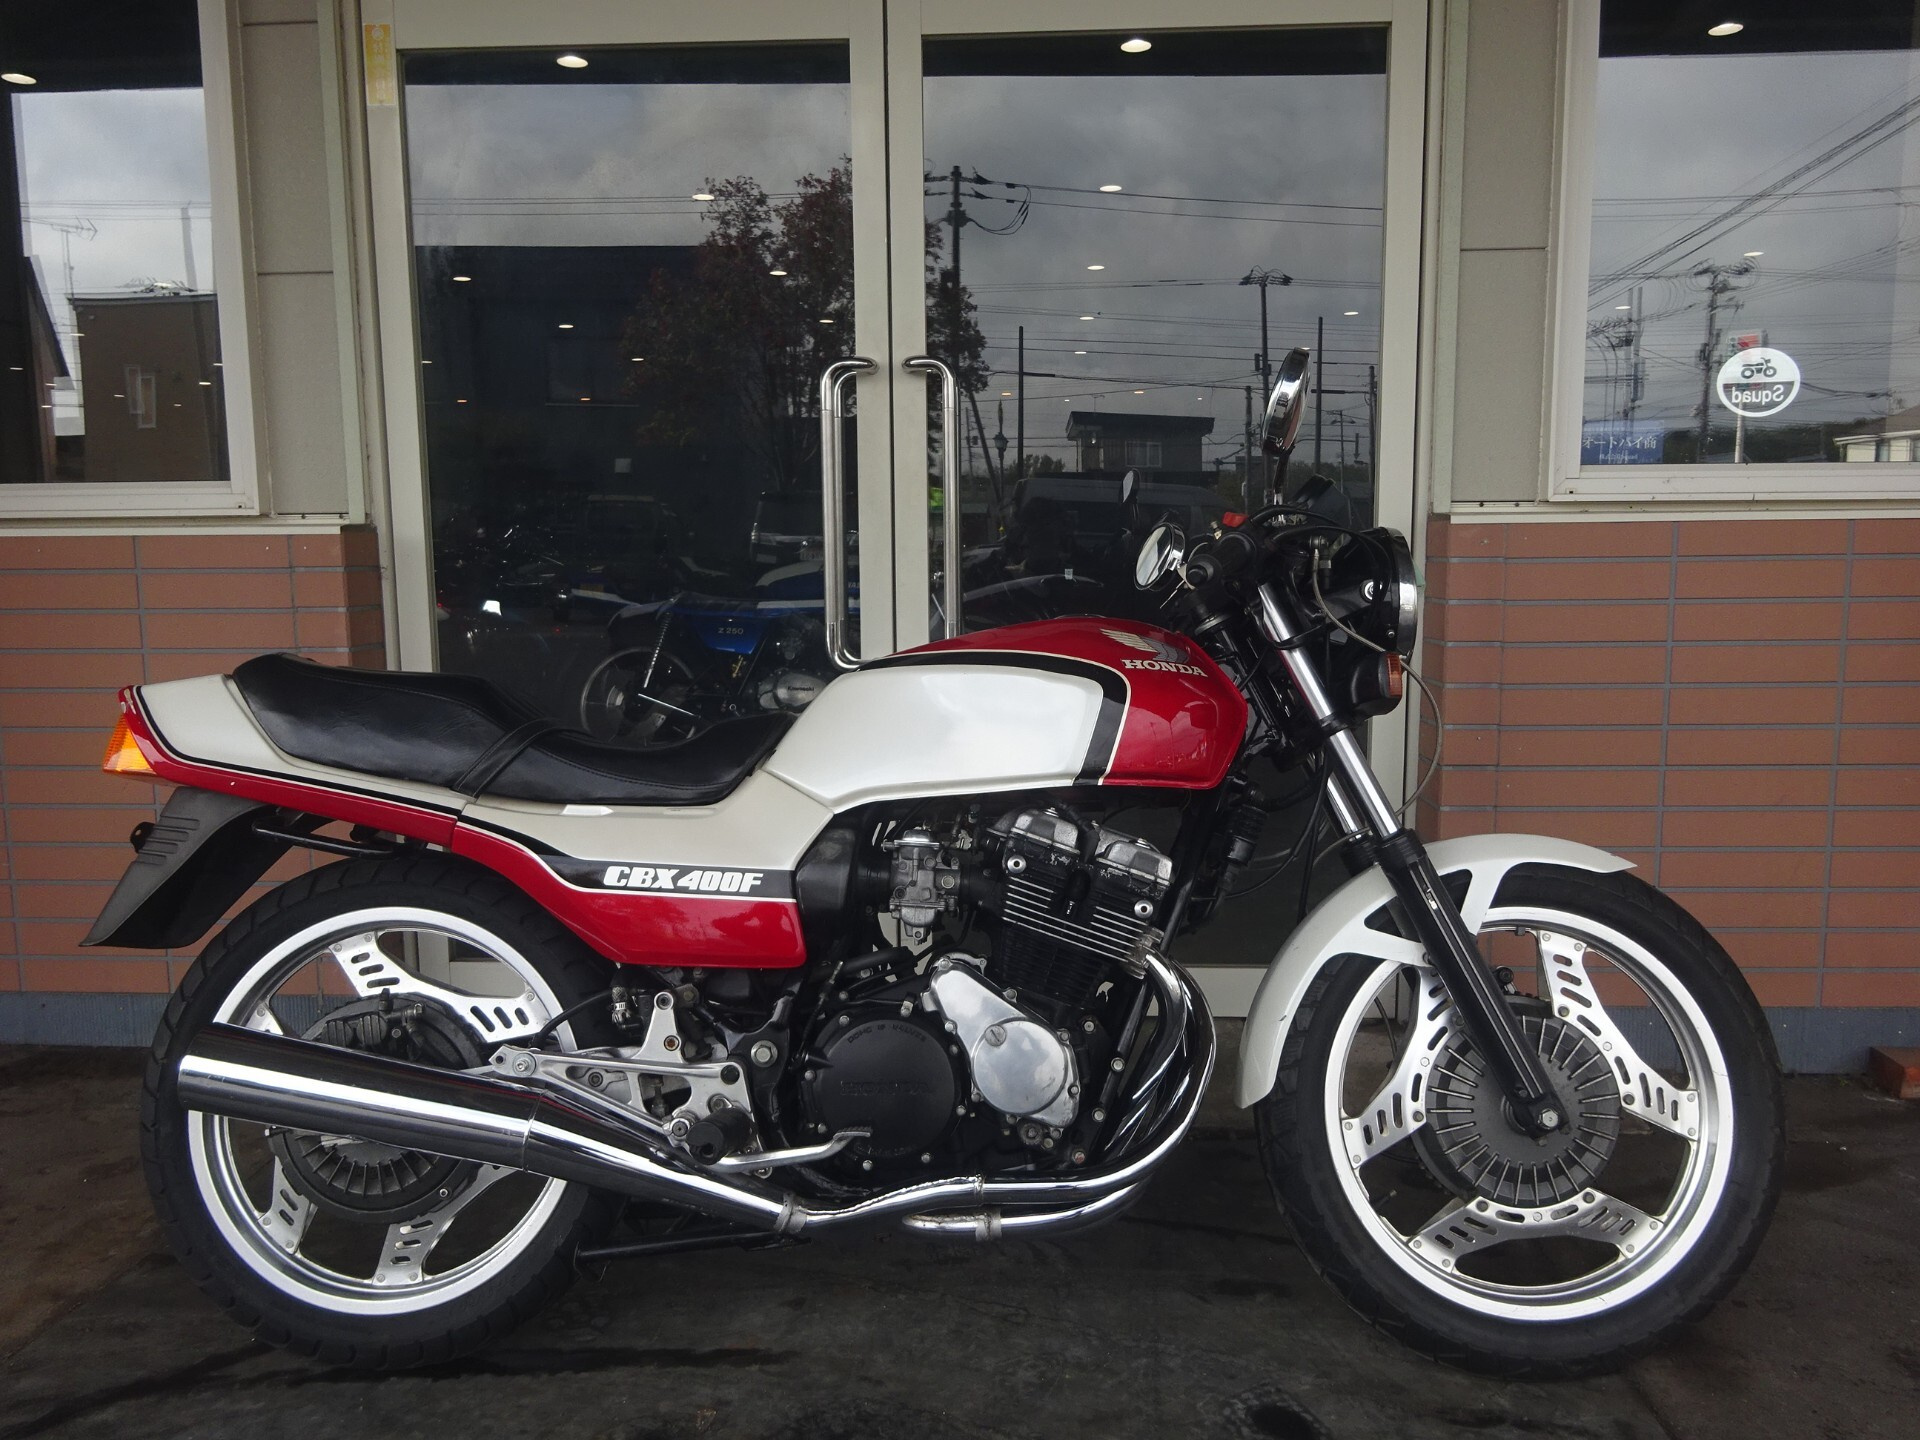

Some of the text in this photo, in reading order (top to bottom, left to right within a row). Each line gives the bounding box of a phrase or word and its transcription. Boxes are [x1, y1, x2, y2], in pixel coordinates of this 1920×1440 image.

[726, 627, 744, 635] 250
[1121, 659, 1208, 678] HONDA
[603, 866, 763, 892] CBX400F
[847, 1026, 873, 1043] DOHC
[892, 1024, 927, 1042] VALVES
[840, 1079, 935, 1096] HONDA
